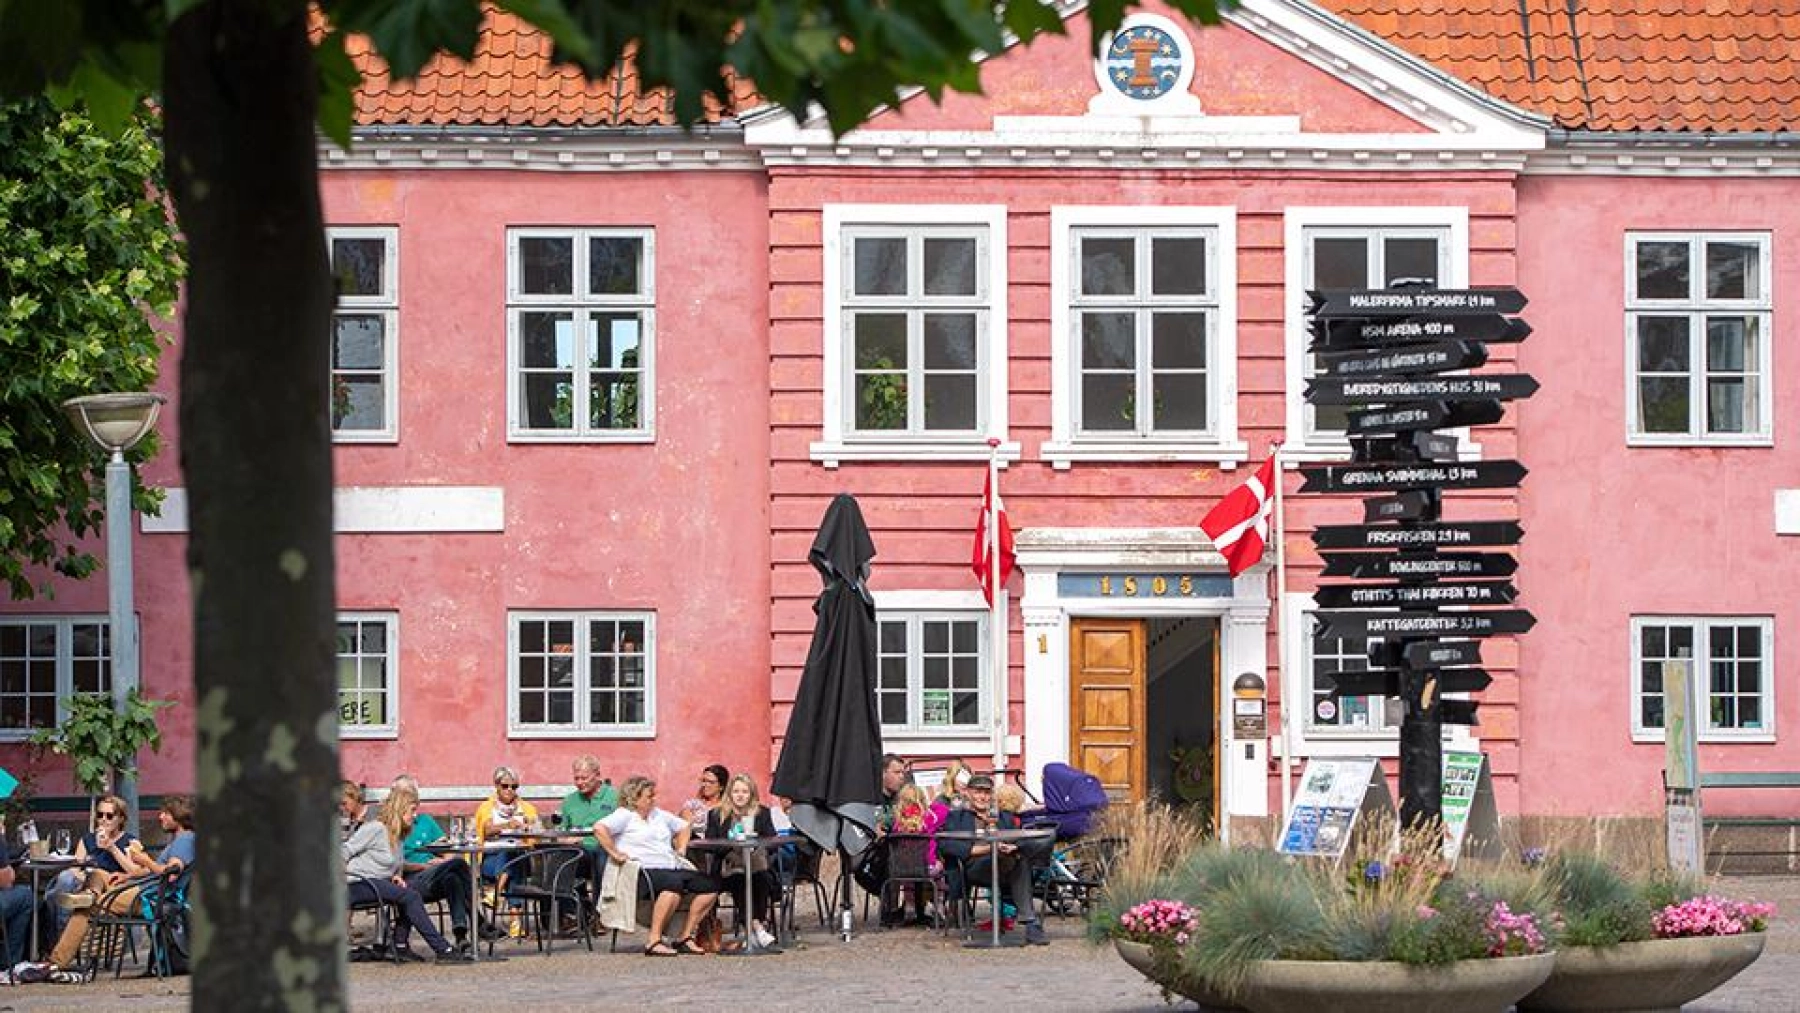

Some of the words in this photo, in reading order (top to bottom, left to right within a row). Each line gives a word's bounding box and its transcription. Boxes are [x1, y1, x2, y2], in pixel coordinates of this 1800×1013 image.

[1480, 294, 1496, 307] km
[1387, 323, 1422, 336] ARENA
[1443, 324, 1454, 334] m
[1449, 381, 1470, 393] HUS
[1485, 381, 1501, 393] km
[1461, 467, 1478, 480] km
[1453, 529, 1470, 542] km
[1389, 561, 1456, 573] BOWLINGCENTER
[1397, 588, 1420, 601] THAI
[1480, 588, 1491, 598] m
[1366, 617, 1458, 631] KATTEGATCENTER
[1475, 617, 1491, 629] km
[1037, 633, 1048, 653] 1
